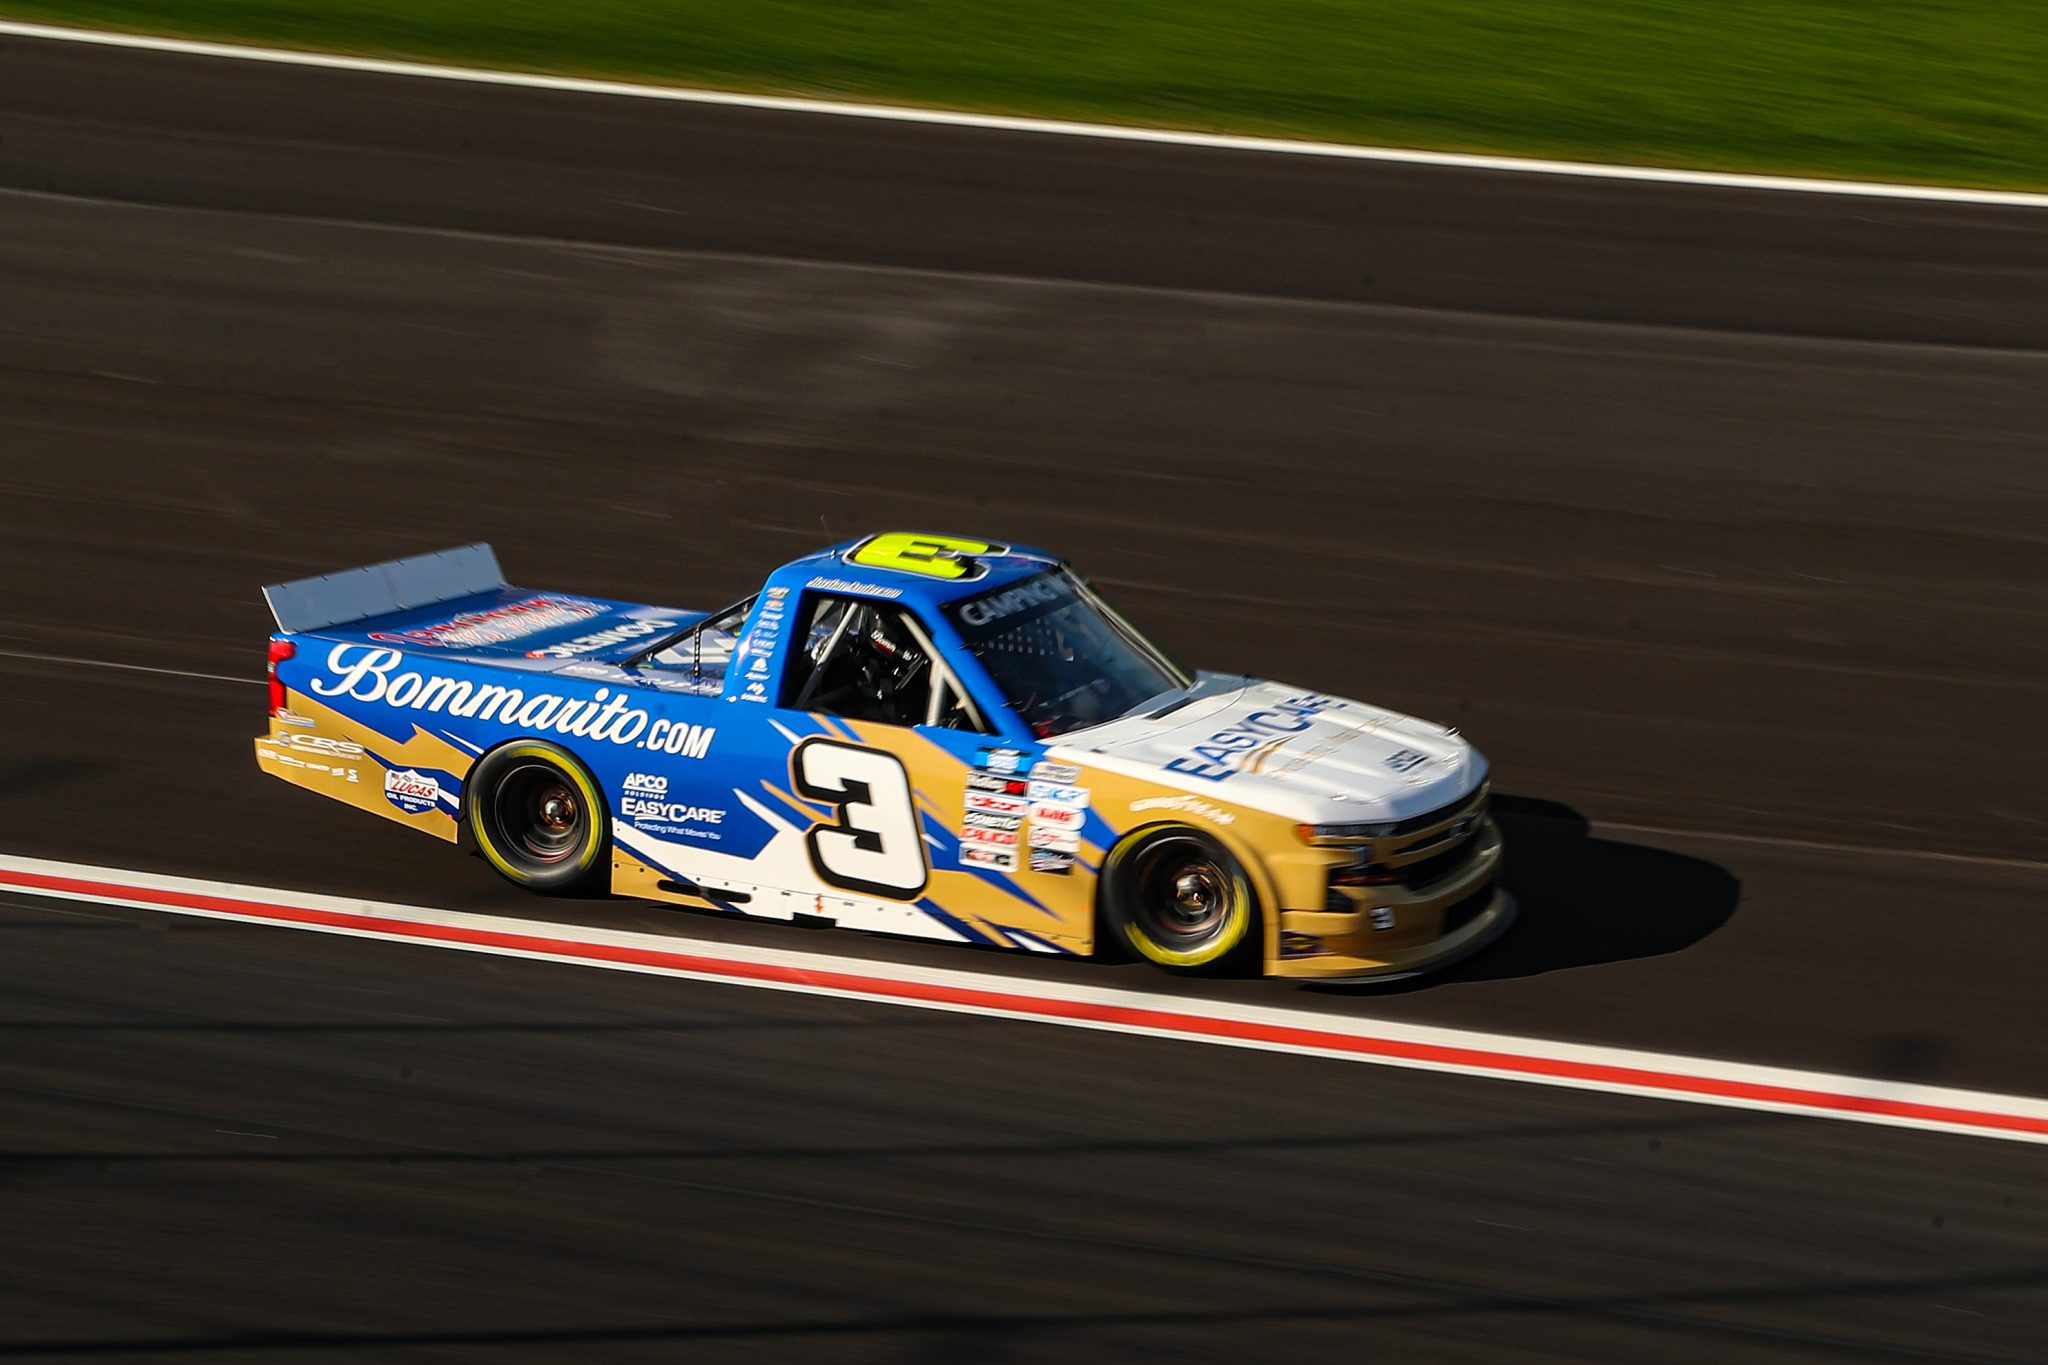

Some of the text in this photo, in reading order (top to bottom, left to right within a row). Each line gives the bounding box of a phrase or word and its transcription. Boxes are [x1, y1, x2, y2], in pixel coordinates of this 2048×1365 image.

[309, 642, 716, 760] Bommarito.COM
[391, 779, 436, 797] LUCAS
[622, 772, 668, 790] APCO
[386, 792, 436, 808] OIL PRODUCTS
[623, 790, 665, 800] HOLDINGS
[795, 738, 927, 899] 3
[634, 821, 722, 840] Protecting What Moves You
[1369, 906, 1397, 932] 3
